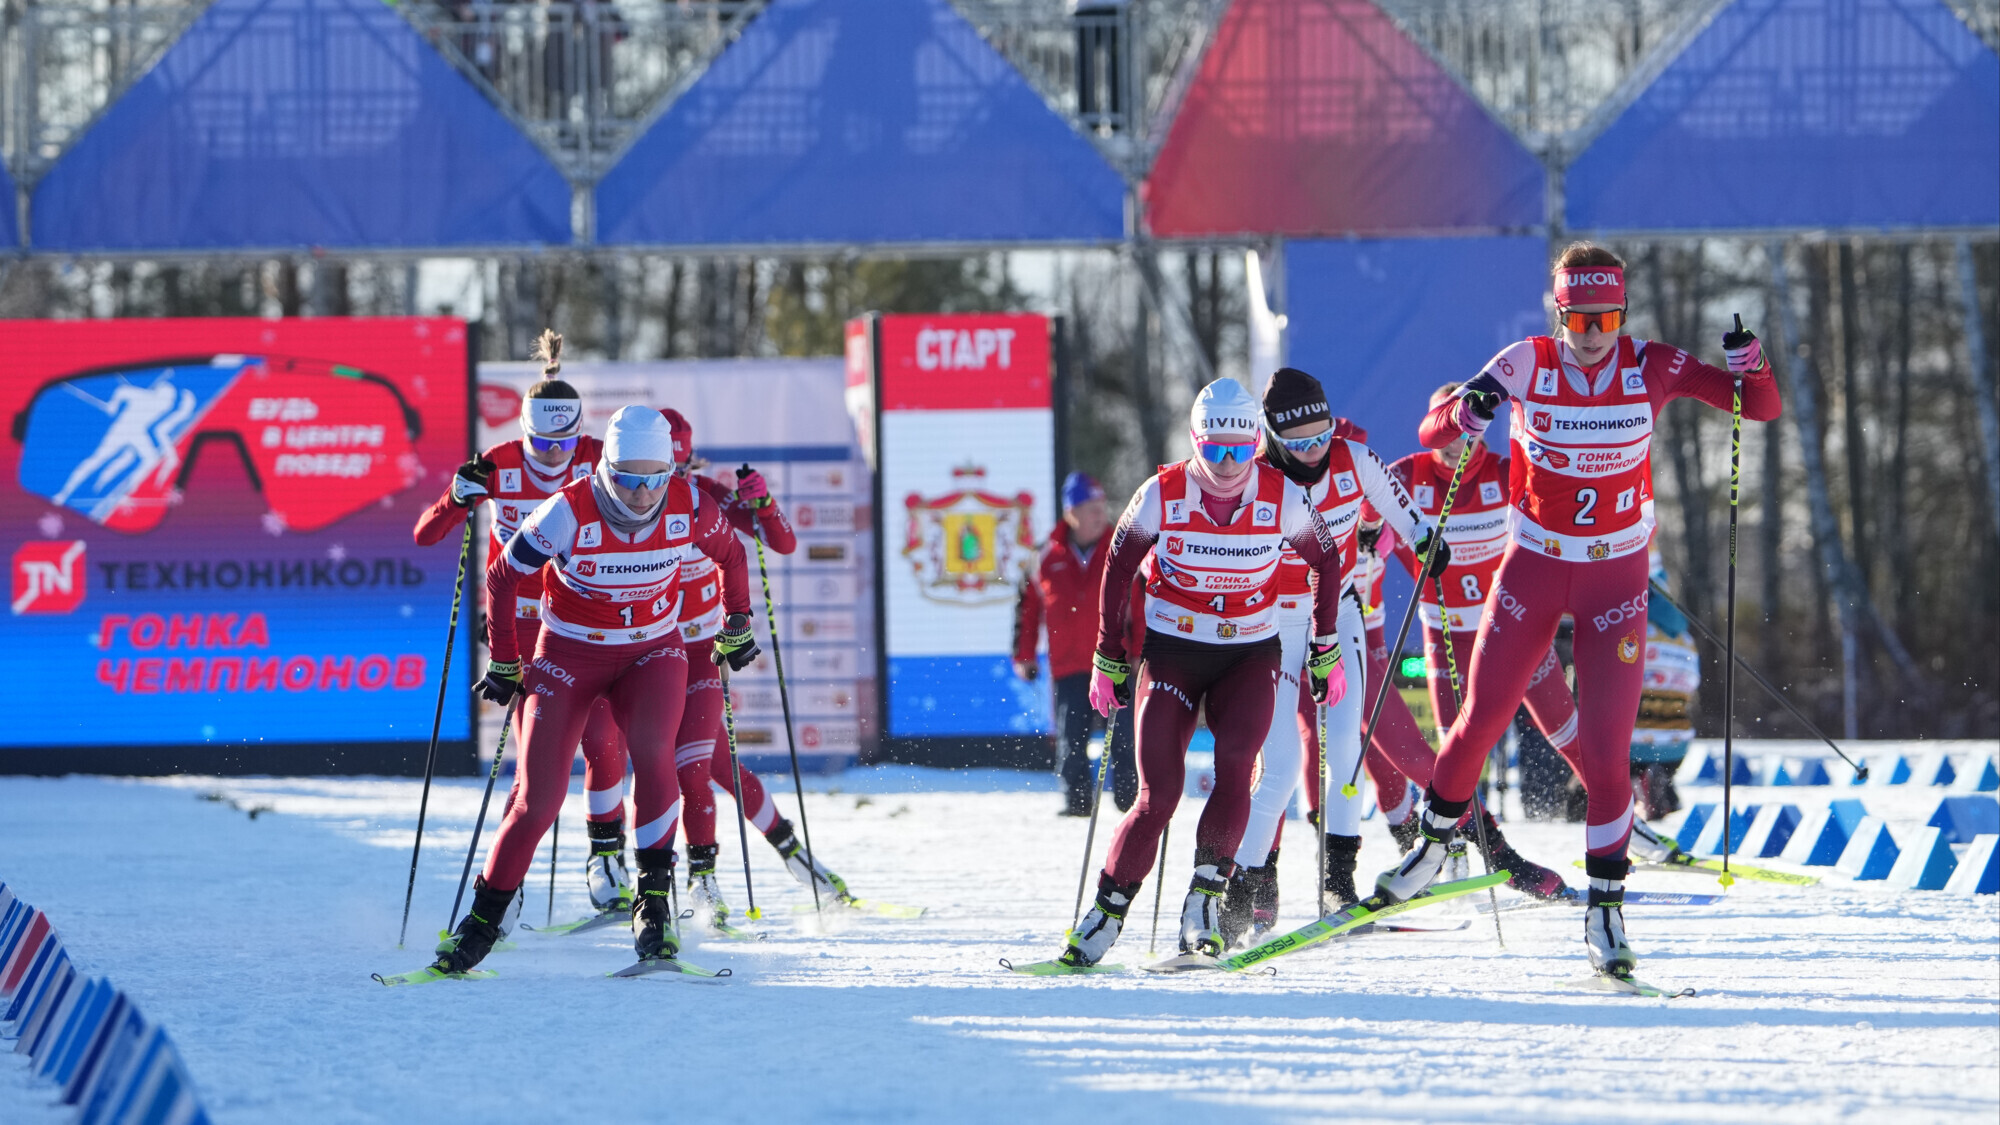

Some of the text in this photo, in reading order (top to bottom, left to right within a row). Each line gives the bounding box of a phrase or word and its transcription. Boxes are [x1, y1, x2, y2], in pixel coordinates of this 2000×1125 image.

[1561, 272, 1619, 288] LUKOIL
[916, 328, 1015, 371] СТАРТ
[248, 398, 318, 421] БУДЬ
[543, 404, 575, 413] LUKOIL
[1200, 417, 1256, 431] BIVIUM
[1554, 416, 1648, 430] ТЕХНОНИКОЛЬ
[262, 425, 385, 449] В ЦЕНТРЕ
[275, 453, 372, 476] ПОБЕД!
[1577, 451, 1622, 462] ГОНКА
[1573, 486, 1599, 526] 2
[1186, 543, 1273, 557] ТЕХНОНИКОЛЬ
[1454, 545, 1488, 554] ГОНКА
[98, 559, 426, 592] ТЕХНОНИКОЛЬ
[1205, 575, 1250, 584] ГОНКА
[1461, 574, 1483, 600] 8
[619, 585, 663, 597] ГОНКА
[618, 604, 634, 627] 1
[1592, 589, 1648, 633] BOSCO
[97, 614, 271, 649] ГОНКА
[97, 655, 427, 694] ЧЕМПИОНОВ
[1147, 681, 1194, 711] BIVIUM
[1241, 935, 1296, 964] FISCHER
